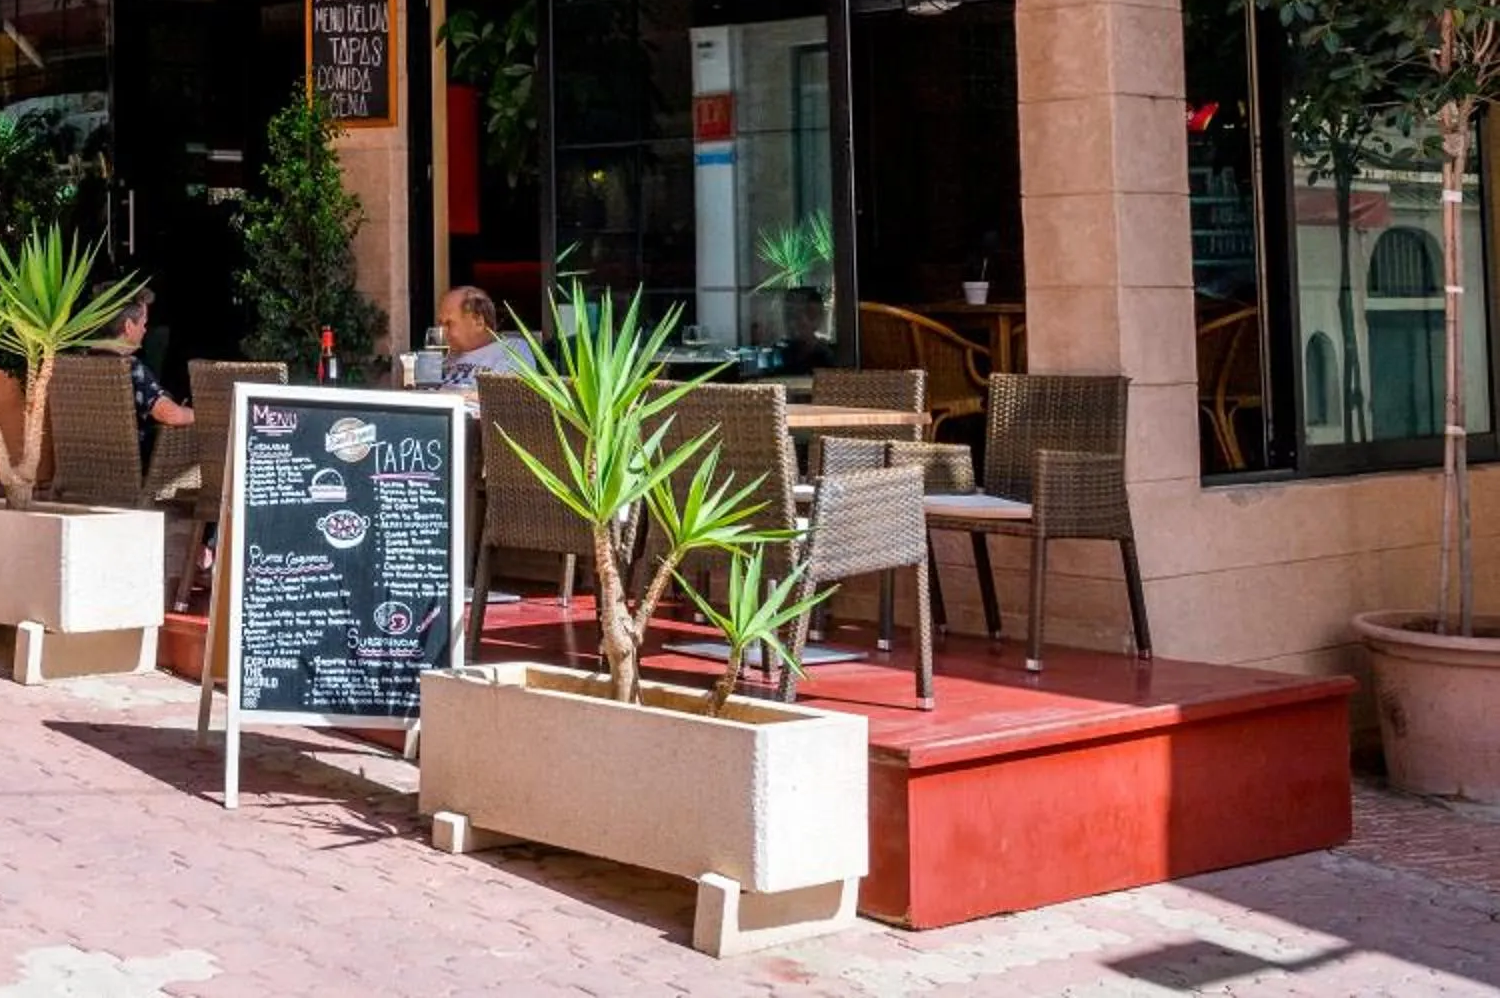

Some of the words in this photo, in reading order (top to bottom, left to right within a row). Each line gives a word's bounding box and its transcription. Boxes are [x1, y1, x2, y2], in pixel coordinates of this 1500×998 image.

[328, 36, 383, 67] TAPAS
[317, 66, 372, 93] COMIDA
[330, 92, 369, 117] CENA
[253, 404, 297, 429] MENU
[370, 437, 442, 475] TAPAS
[244, 667, 263, 677] THE
[244, 676, 278, 688] WORLD
